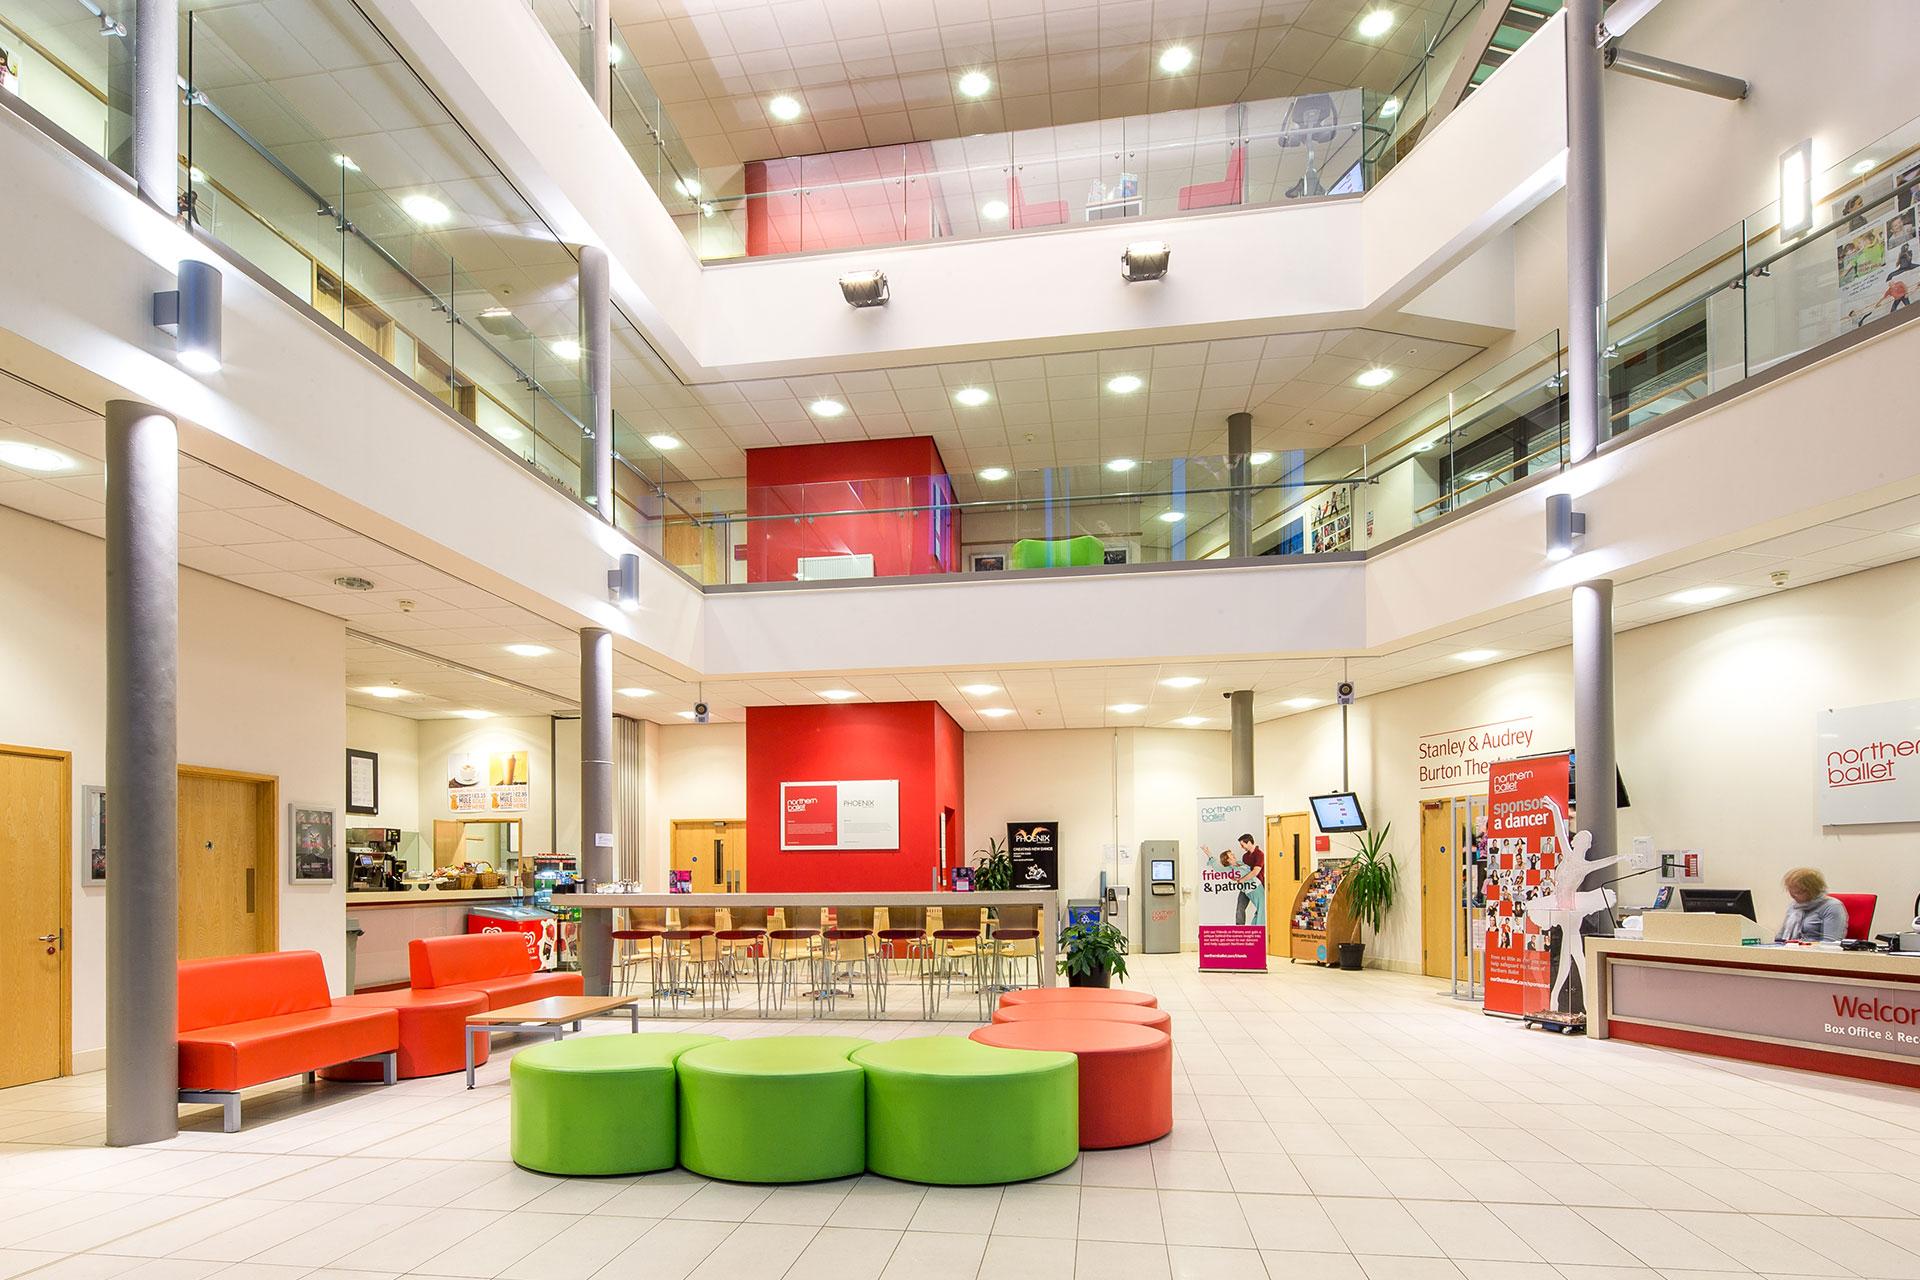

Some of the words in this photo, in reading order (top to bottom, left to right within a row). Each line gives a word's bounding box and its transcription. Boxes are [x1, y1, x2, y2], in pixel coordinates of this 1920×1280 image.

[1419, 738, 1466, 759] Stanley
[1468, 735, 1479, 752] &
[1481, 728, 1533, 748] Audrey
[1419, 764, 1462, 782] Burton
[1494, 770, 1534, 784] northern
[1828, 759, 1896, 785] ballet
[1494, 781, 1519, 793] ballet
[843, 799, 875, 807] PHOENIX
[1201, 805, 1241, 815] northern
[1493, 797, 1544, 817] sponsor
[1494, 818, 1503, 830] a
[1505, 812, 1550, 830] dancer
[1015, 834, 1050, 842] PHOENIX
[1202, 869, 1241, 881] friends
[1204, 882, 1213, 892] &
[1215, 880, 1258, 895] patrons
[1824, 1023, 1846, 1035] Box
[1847, 1026, 1882, 1039] Office
[1885, 1031, 1894, 1041] &
